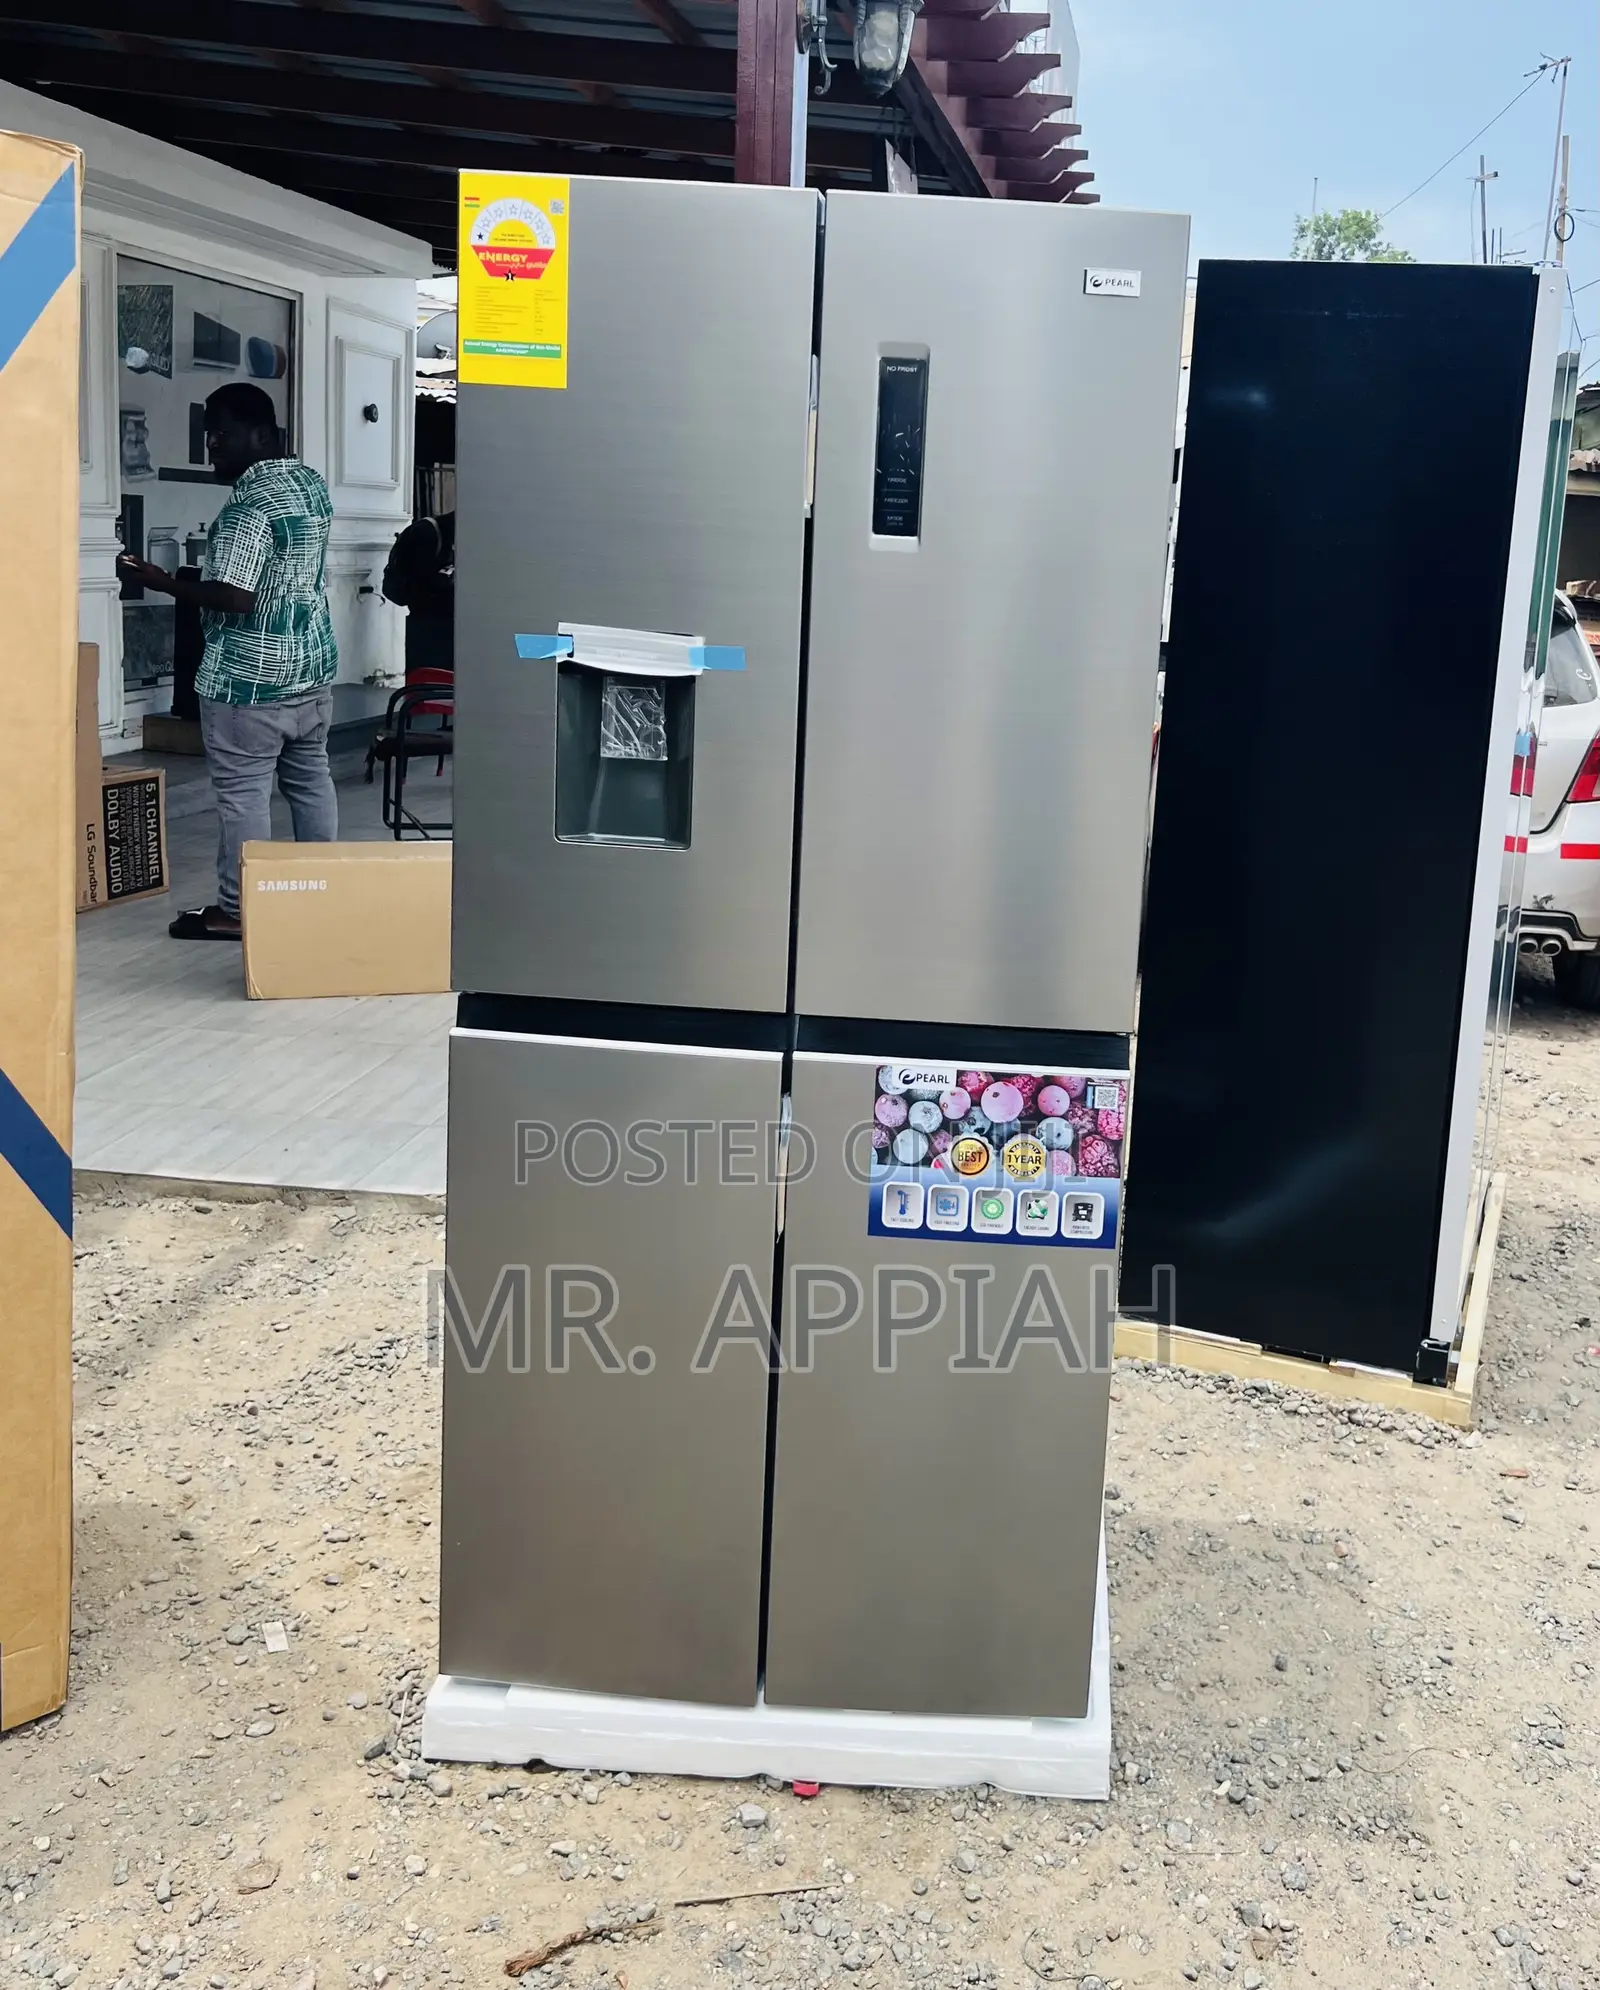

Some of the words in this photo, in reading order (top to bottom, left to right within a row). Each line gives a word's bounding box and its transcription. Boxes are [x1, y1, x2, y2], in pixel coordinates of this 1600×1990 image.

[478, 251, 528, 263] ENERGY
[1105, 278, 1134, 288] PEARL
[107, 789, 120, 840] DOLBY
[86, 823, 96, 841] LG
[87, 845, 98, 904] Soundbar
[109, 845, 122, 893] AUDIO
[136, 878, 143, 887] TV
[257, 880, 327, 891] SAMSUNG
[916, 1073, 949, 1084] PEARL
[957, 1151, 983, 1163] BEST
[1013, 1154, 1041, 1165] YEAR
